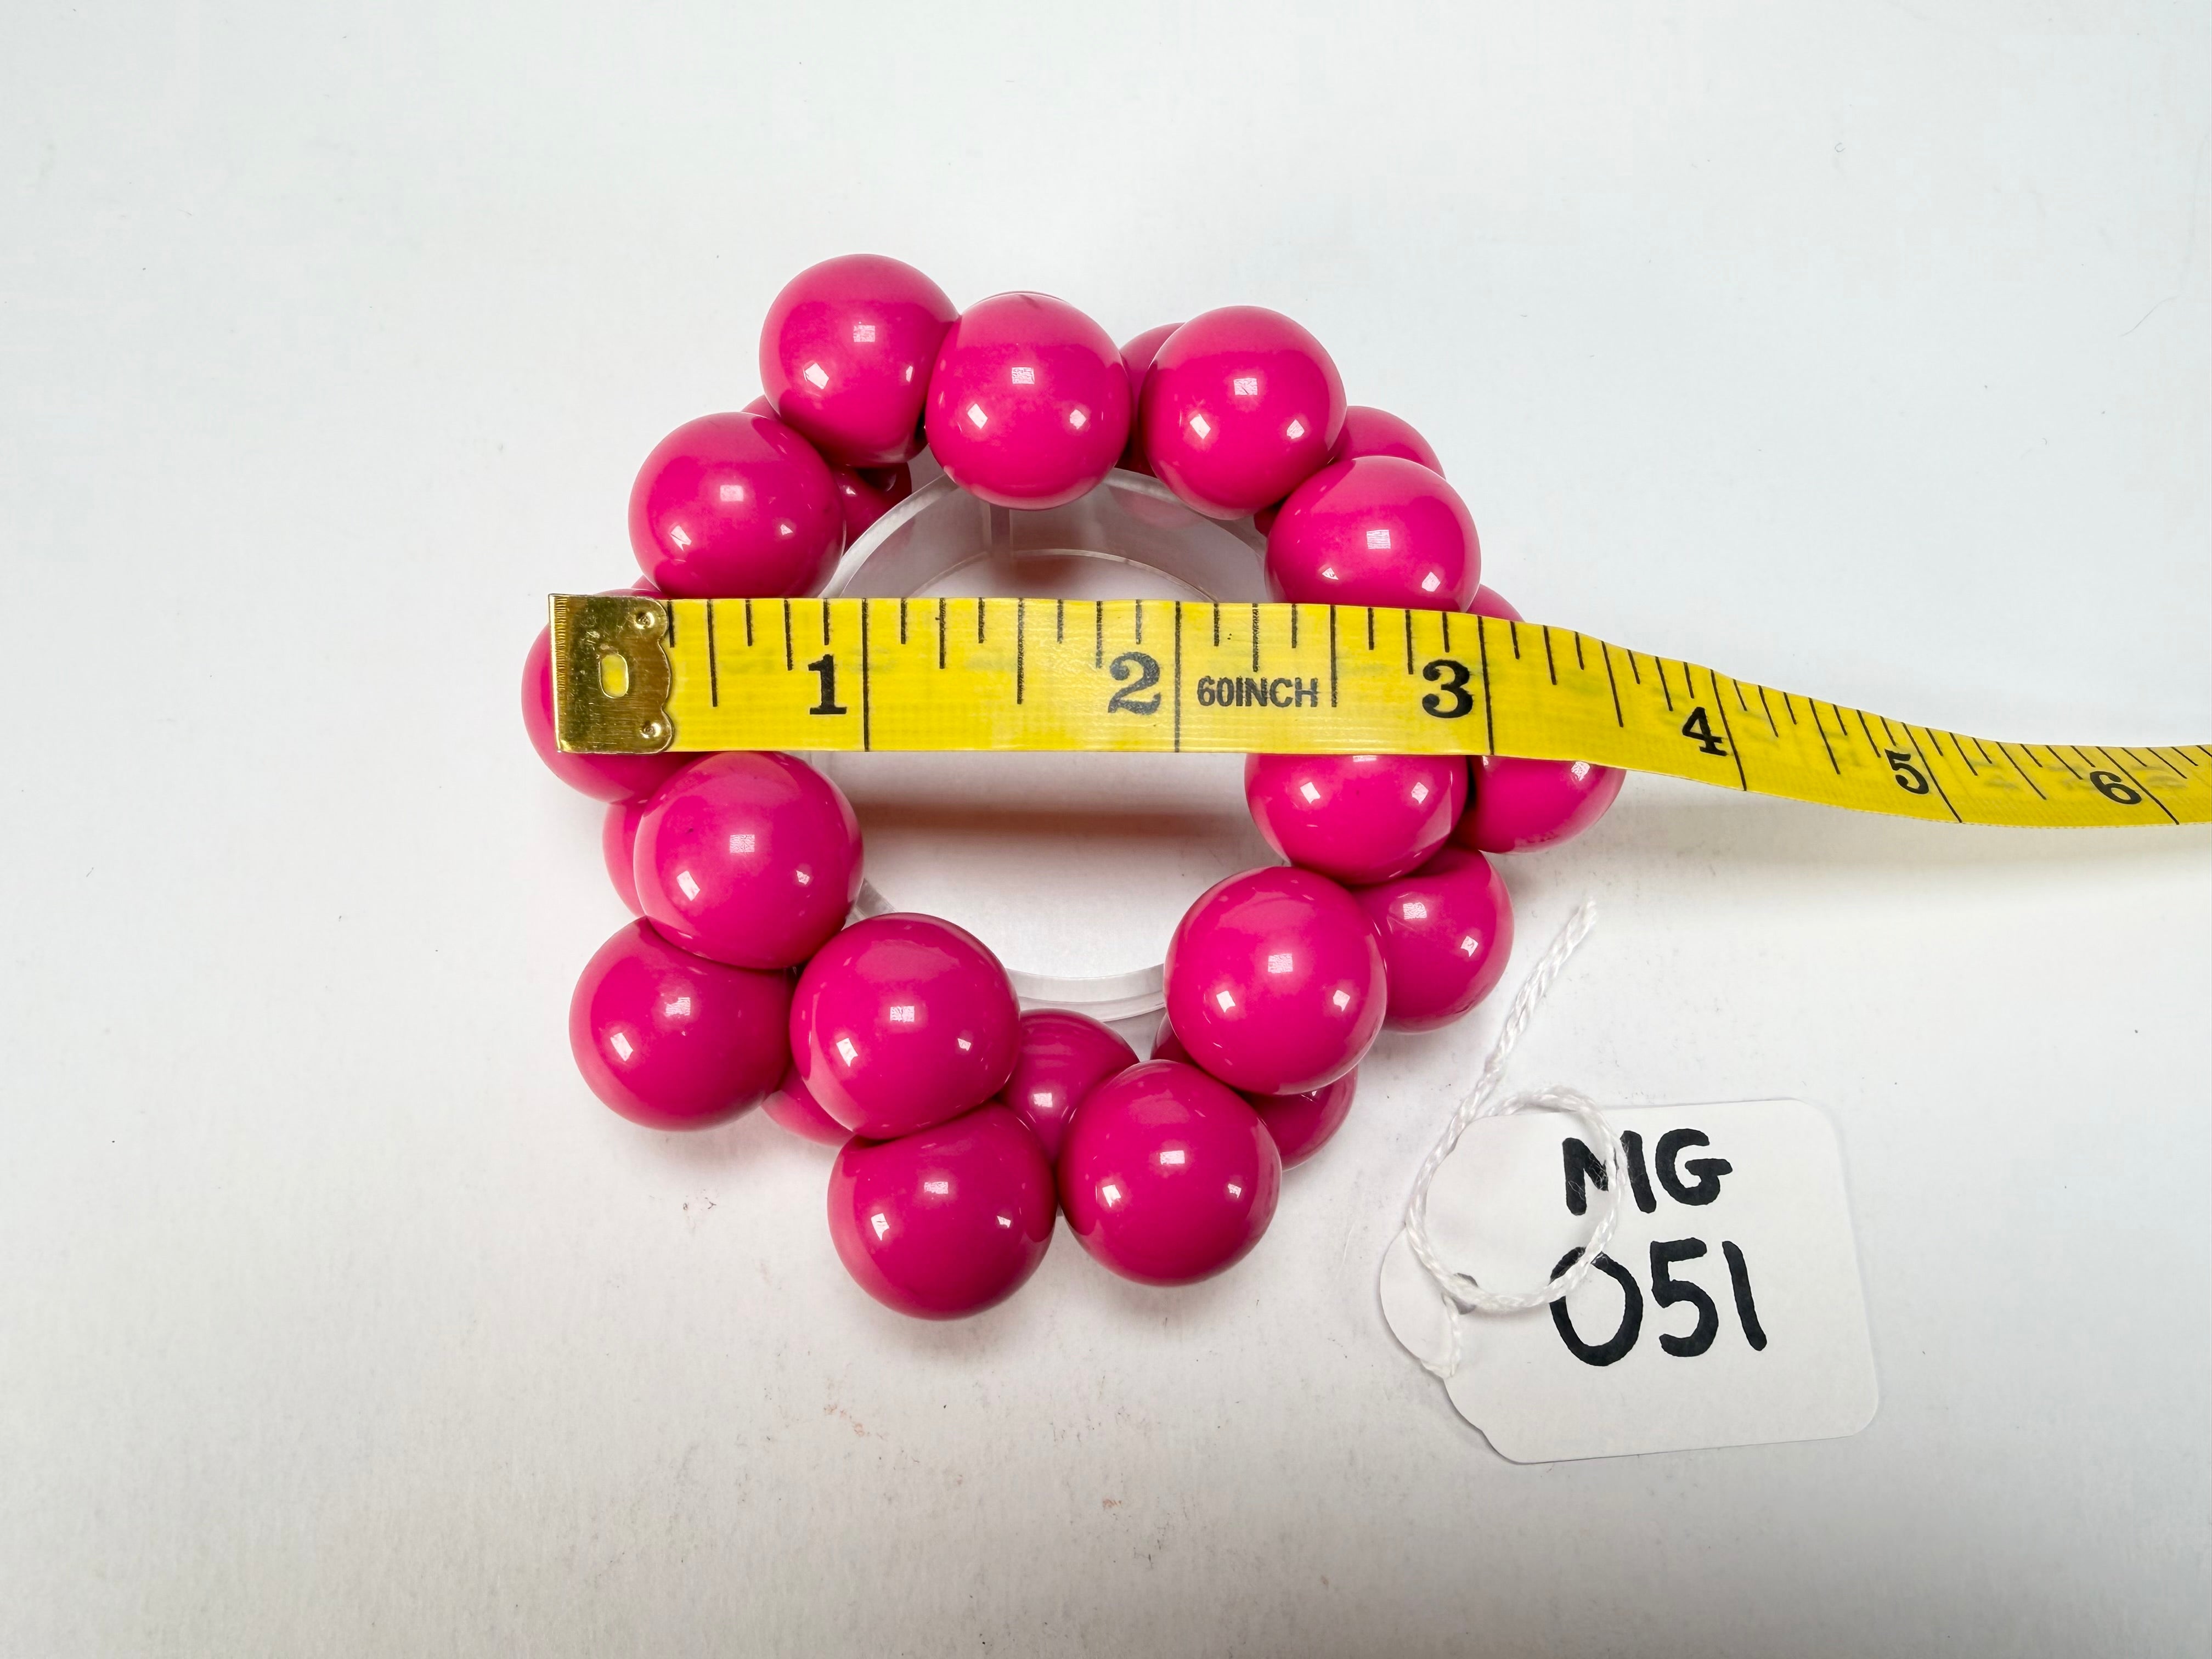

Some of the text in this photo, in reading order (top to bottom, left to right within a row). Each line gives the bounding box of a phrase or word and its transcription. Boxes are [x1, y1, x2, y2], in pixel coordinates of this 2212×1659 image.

[808, 651, 2142, 805] 1 2 60INCH 3 4 5 6
[1562, 1128, 1733, 1215] MG
[1549, 1238, 1767, 1367] 051
